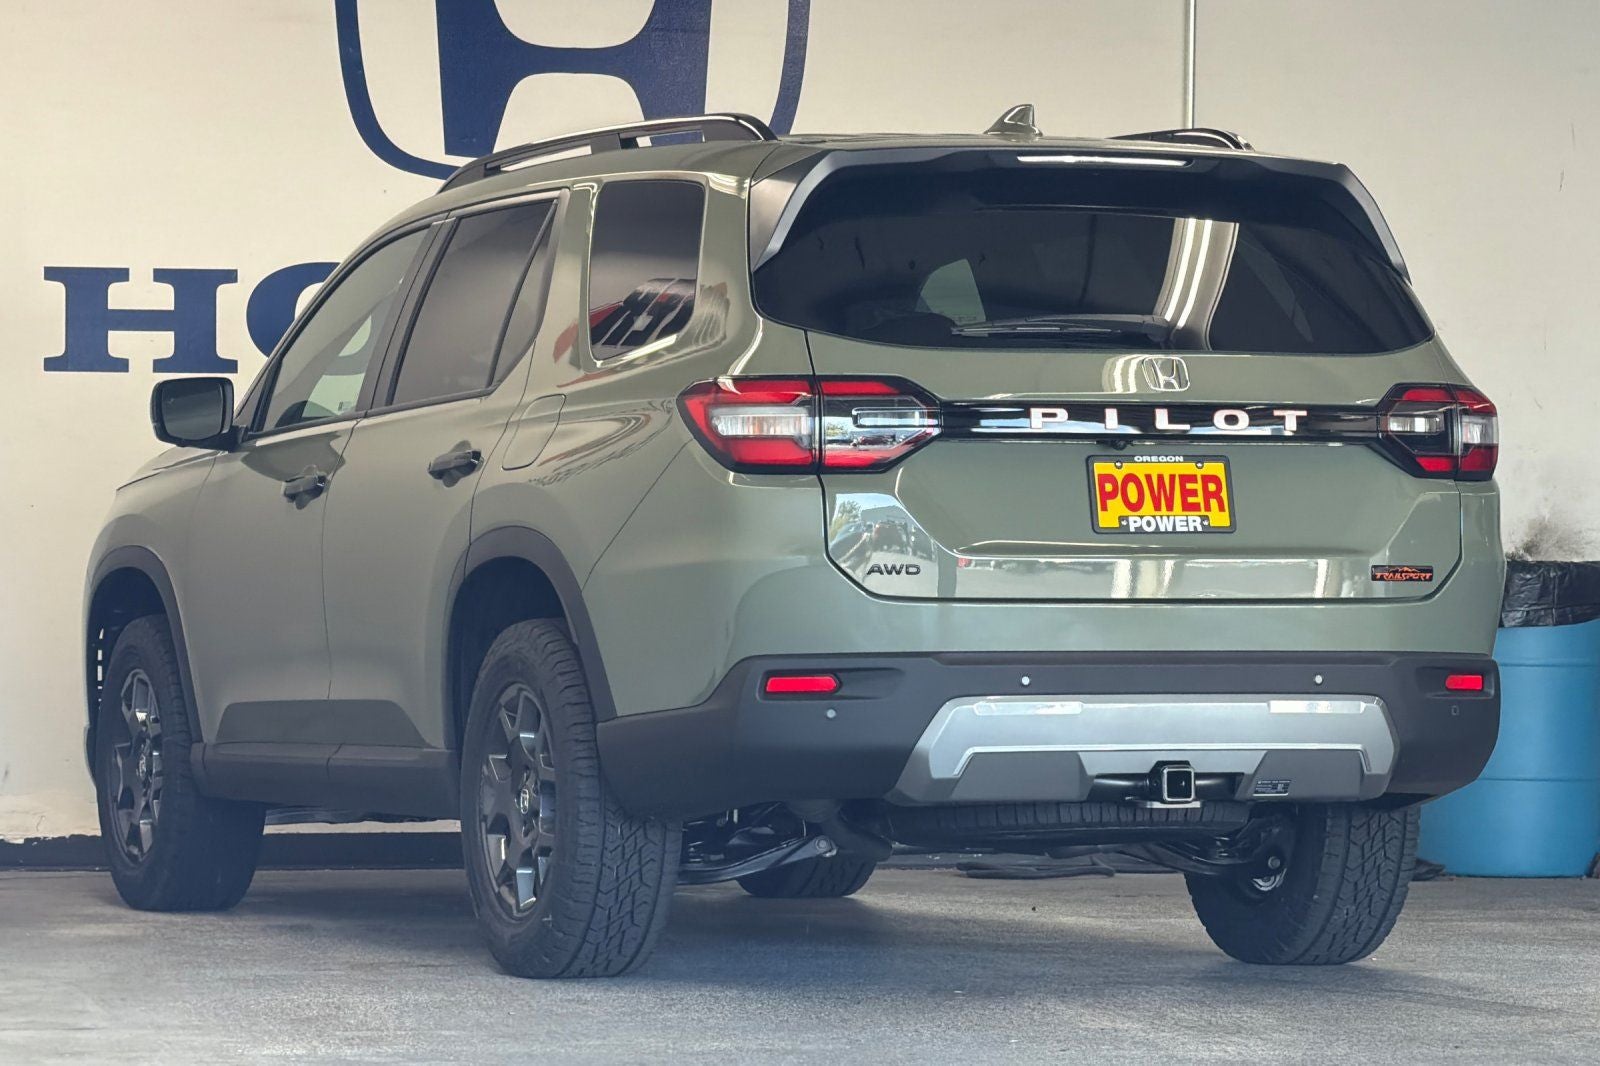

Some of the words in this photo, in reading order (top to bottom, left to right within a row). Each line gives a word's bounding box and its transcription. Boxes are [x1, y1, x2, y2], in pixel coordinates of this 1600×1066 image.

[1029, 407, 1308, 431] PILOT
[1097, 473, 1226, 512] POWER
[1128, 516, 1203, 532] POWER
[866, 563, 921, 576] AWD
[1374, 572, 1433, 581] TRAILSPORT
